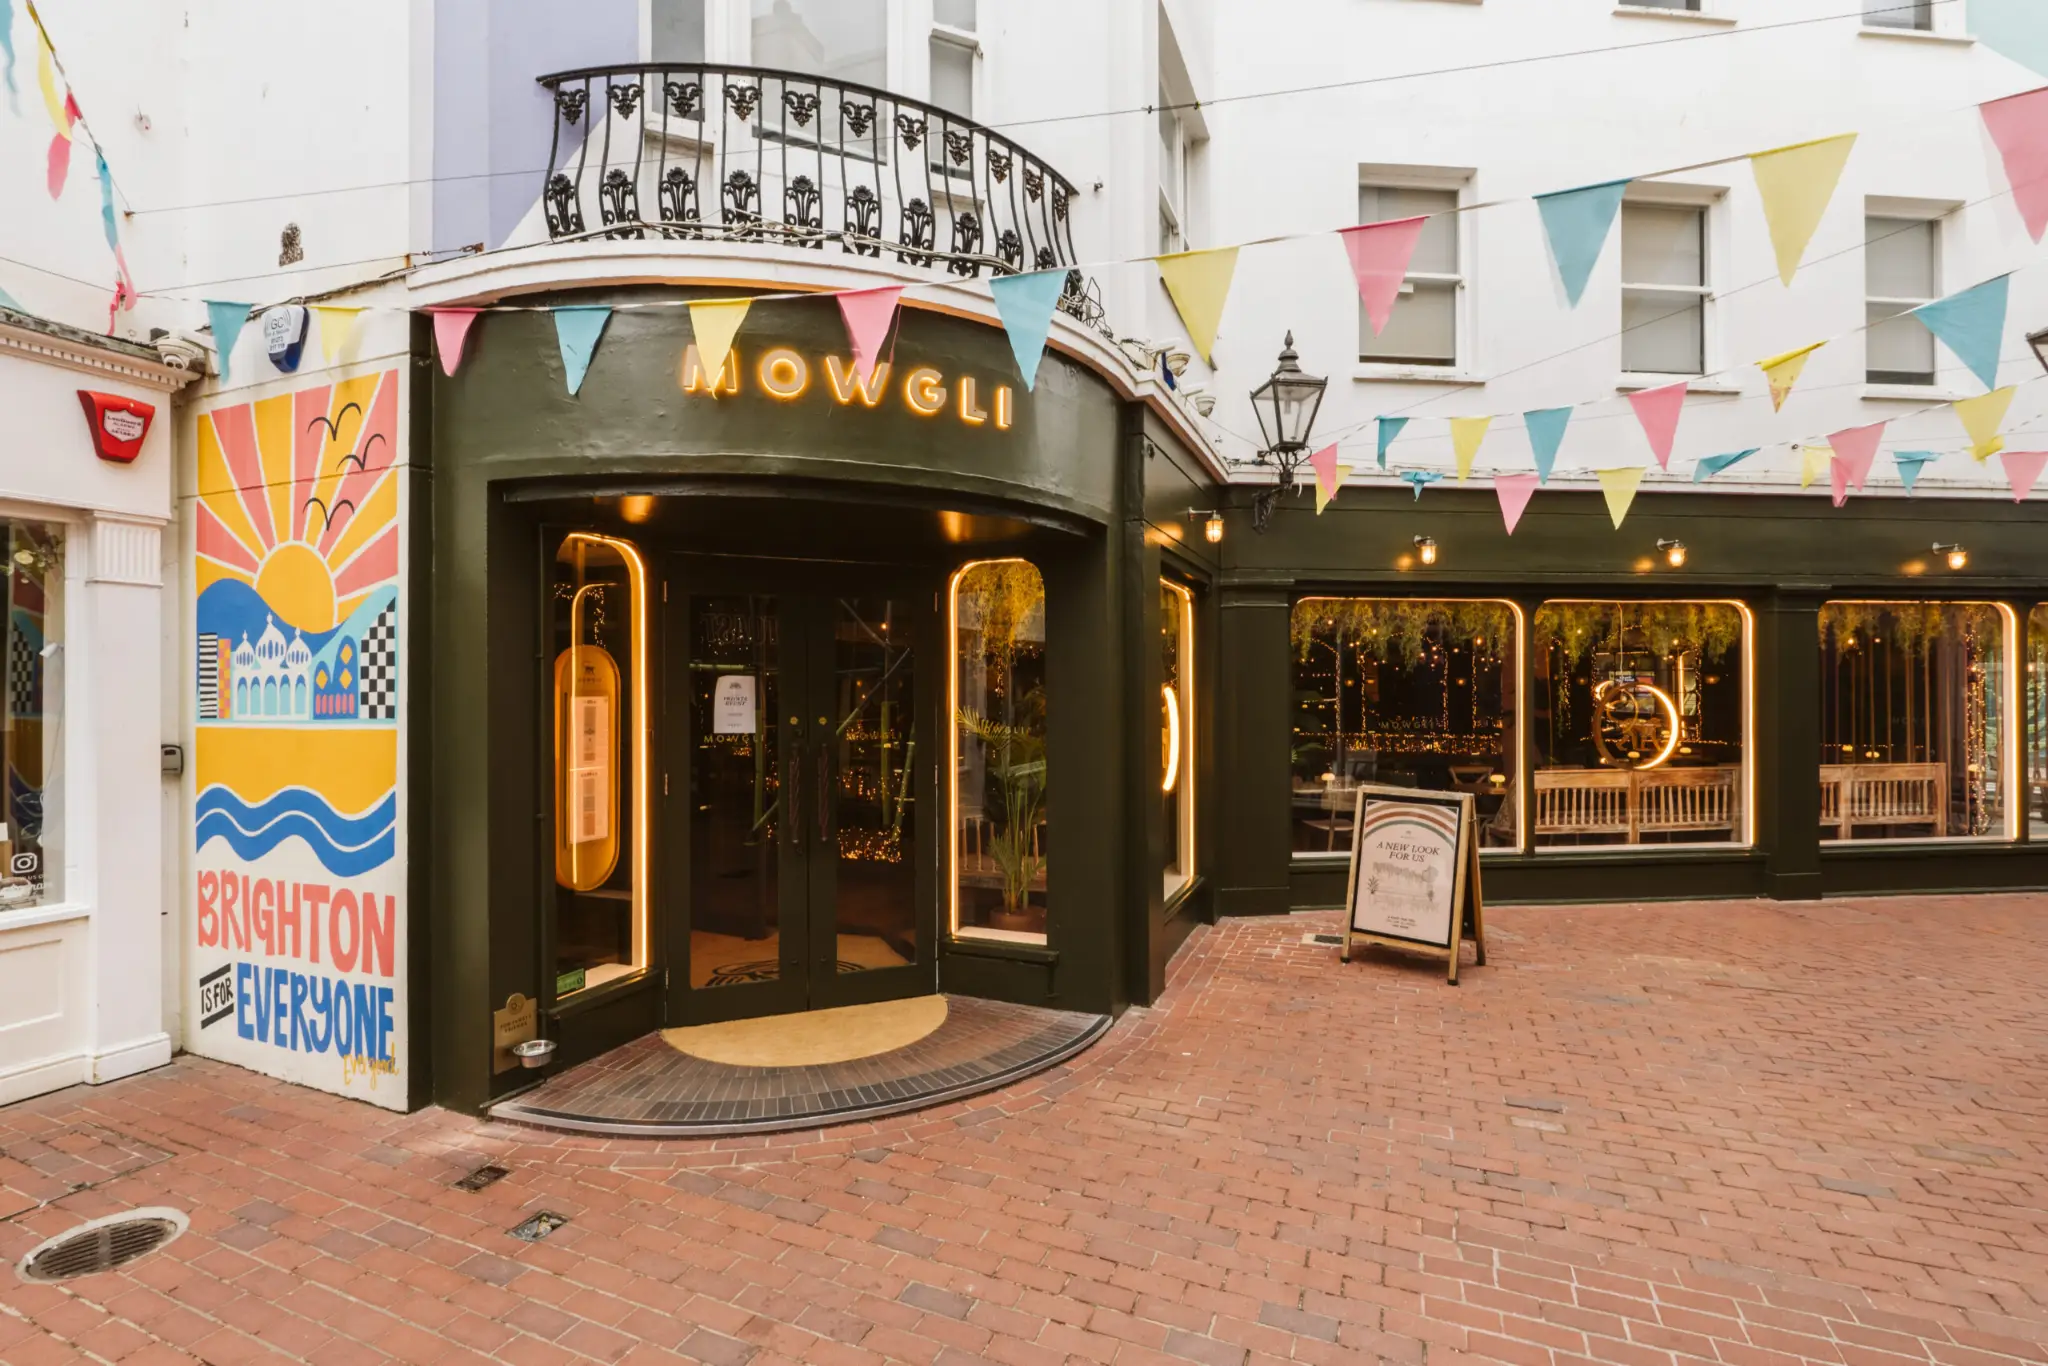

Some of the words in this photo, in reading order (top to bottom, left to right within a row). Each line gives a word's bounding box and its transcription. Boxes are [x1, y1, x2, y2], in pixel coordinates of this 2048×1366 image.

[682, 344, 1013, 427] MOWGLI
[1376, 841, 1383, 849] A
[1385, 842, 1410, 851] NEW
[1411, 844, 1440, 856] LOOK
[1388, 851, 1410, 861] FOR
[1411, 853, 1425, 863] US
[197, 869, 396, 978] BRIGHTON
[201, 986, 213, 1015] IS
[213, 976, 234, 1009] FOR
[237, 962, 396, 1067] EVERYONE
